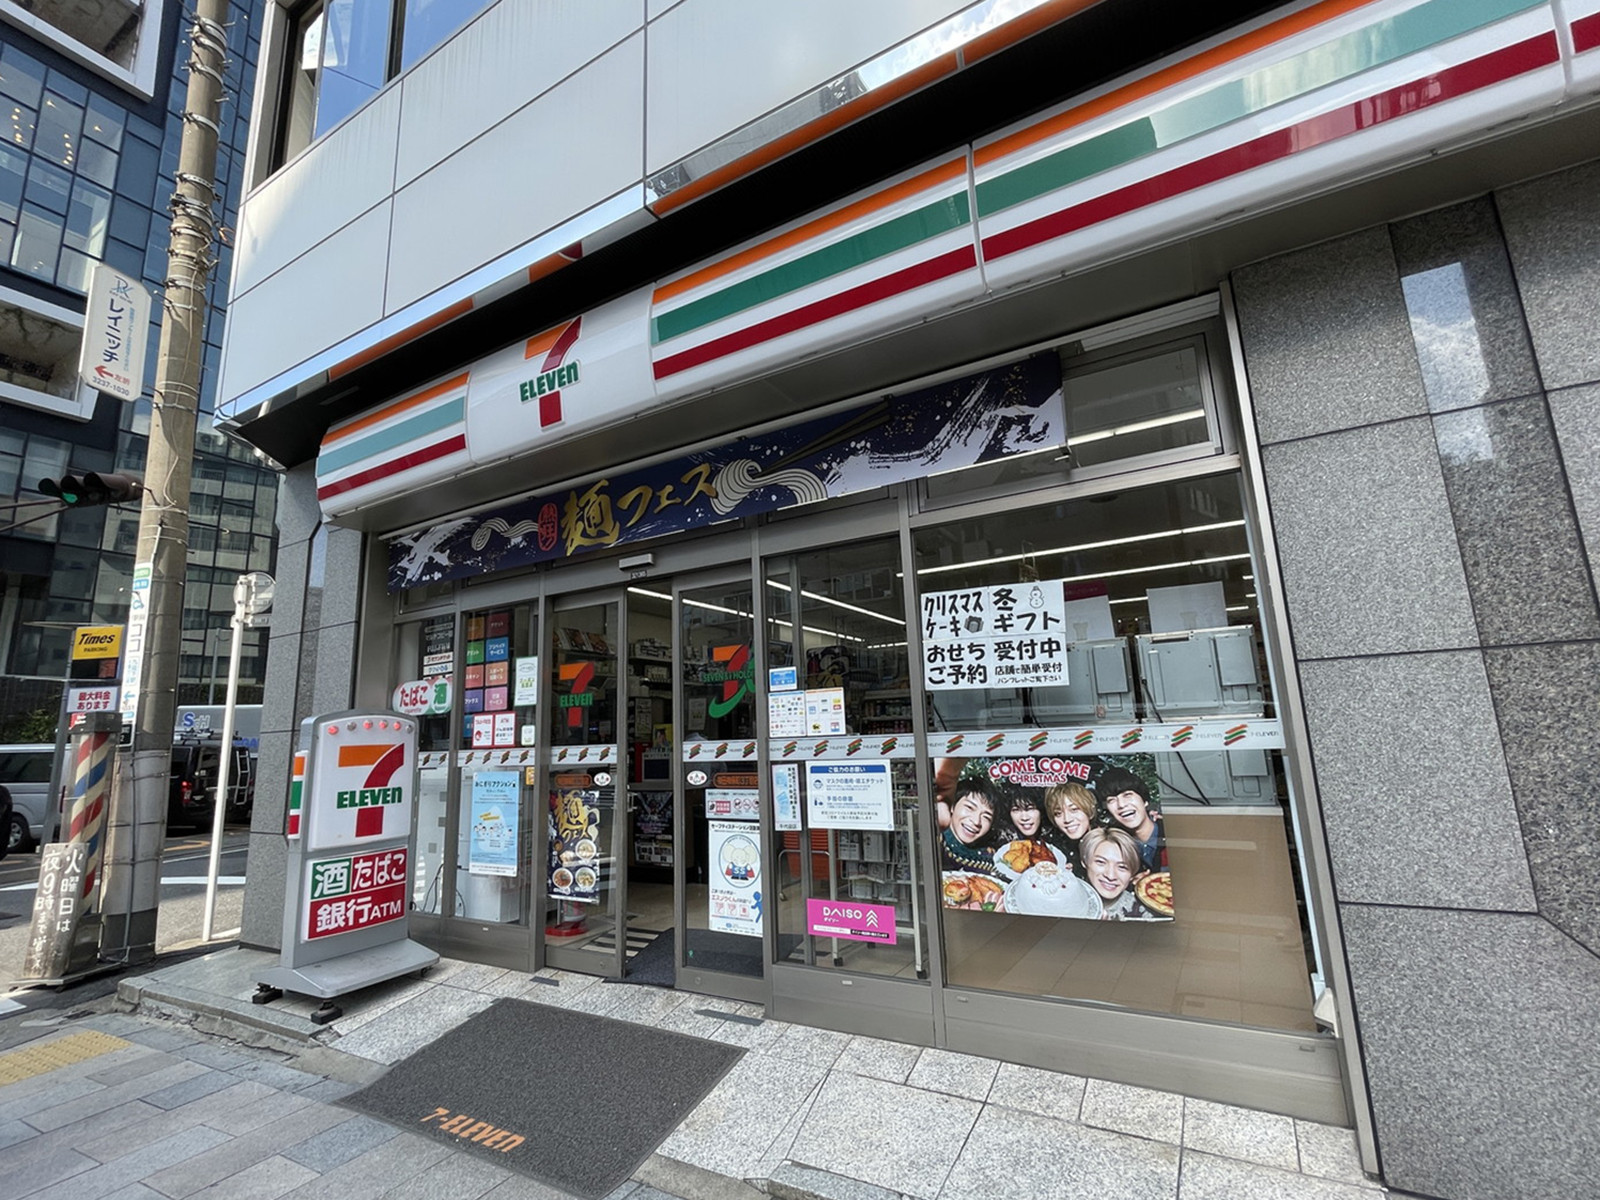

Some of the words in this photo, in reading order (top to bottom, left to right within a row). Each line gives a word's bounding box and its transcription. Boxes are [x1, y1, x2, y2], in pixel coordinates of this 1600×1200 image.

[924, 591, 984, 617] クリスマス
[993, 588, 1018, 611] 冬
[926, 616, 961, 638] ケーキ
[994, 611, 1061, 632] ギフト
[79, 633, 115, 645] Times
[994, 637, 1061, 661] 受付中
[927, 642, 986, 663] おせち
[928, 664, 988, 685] ご予約
[995, 662, 1062, 675] 店舗で簡単受付
[77, 701, 110, 710] あります
[78, 691, 111, 701] 最大料金
[400, 684, 428, 707] たばこ
[989, 758, 1035, 779] COME
[1039, 758, 1089, 779] COME
[1010, 774, 1067, 783] CHRISTMAS
[313, 861, 350, 898] 酒
[353, 853, 405, 890] たばこ
[56, 849, 83, 932] 火曜日は
[823, 906, 863, 919] DAISO
